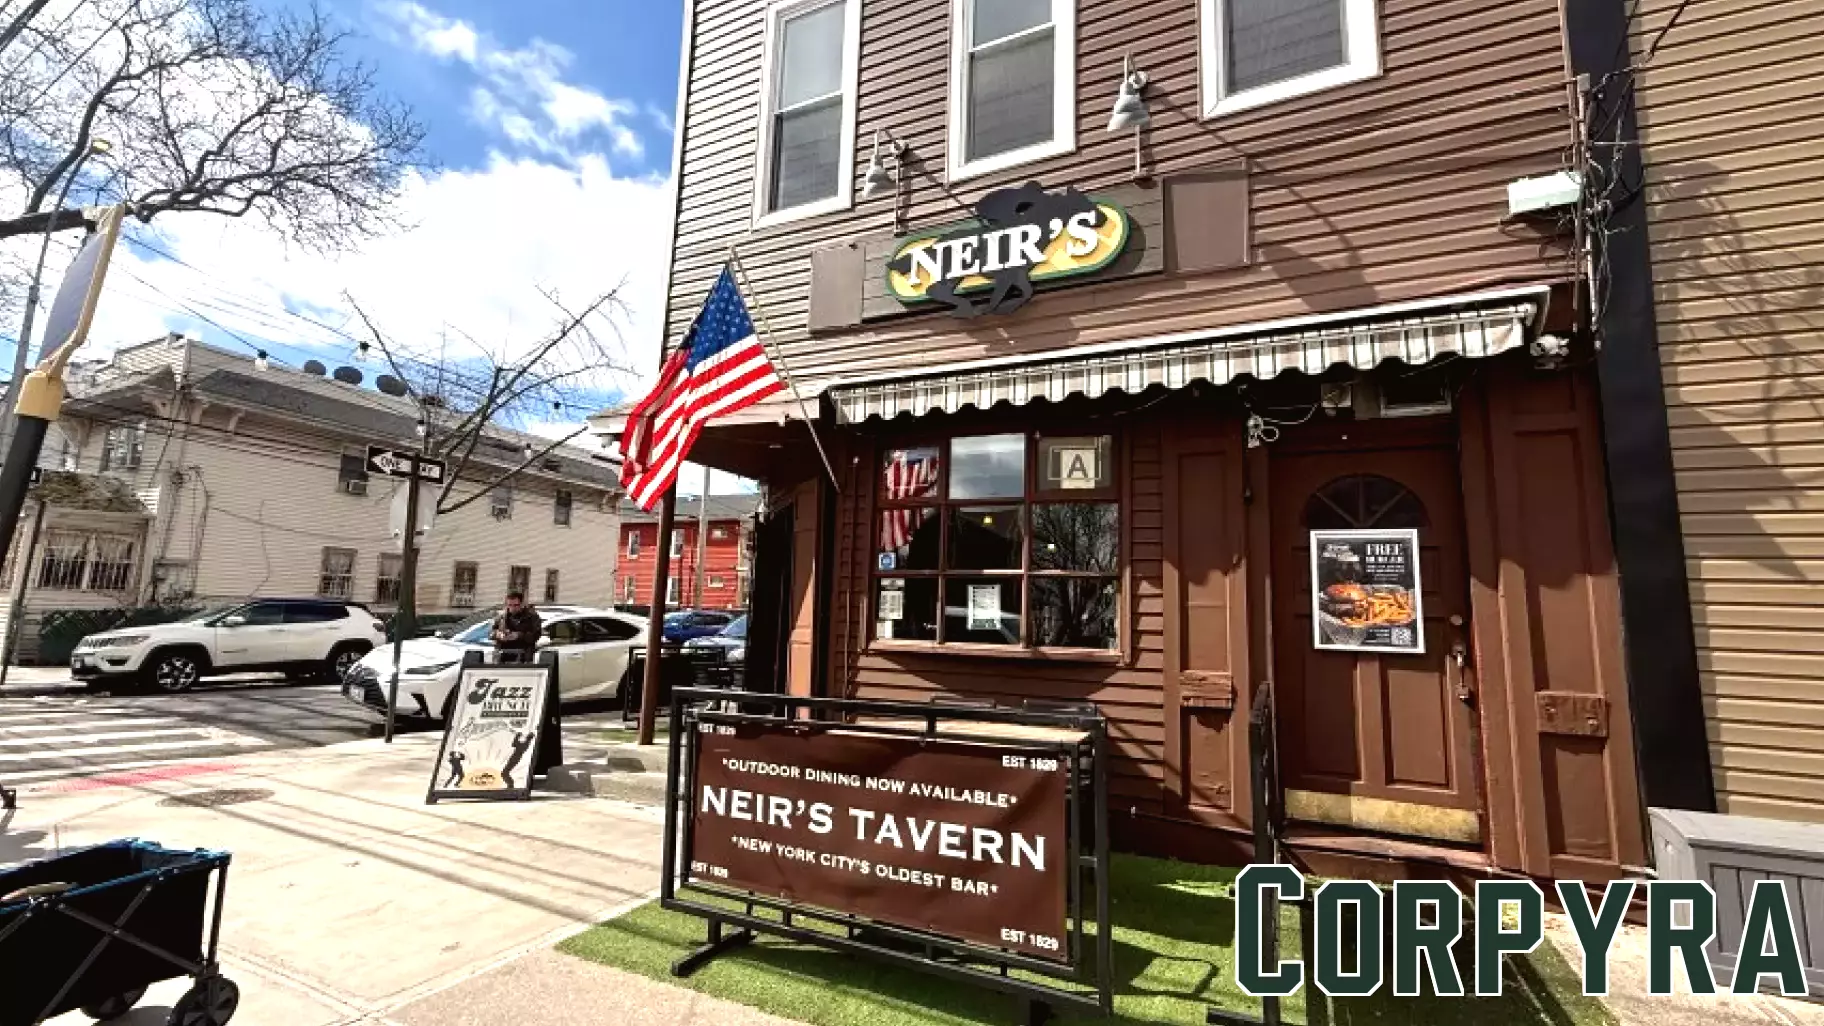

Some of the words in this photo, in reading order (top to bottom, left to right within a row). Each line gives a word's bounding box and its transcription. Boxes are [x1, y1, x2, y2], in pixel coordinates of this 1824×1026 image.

[905, 210, 1099, 285] NEIR'S
[1067, 453, 1089, 479] A
[1366, 543, 1403, 556] FREE
[1002, 755, 1027, 769] EST
[805, 768, 862, 788] DINING
[865, 776, 906, 794] NOW
[701, 784, 835, 834] NEIR'S
[848, 806, 1047, 872] TAVERN
[775, 844, 816, 864] YORK
[819, 852, 871, 875] CITY'S
[875, 863, 946, 888] OLDEST
[1001, 928, 1027, 944] EST
[1028, 934, 1060, 952] 1829
